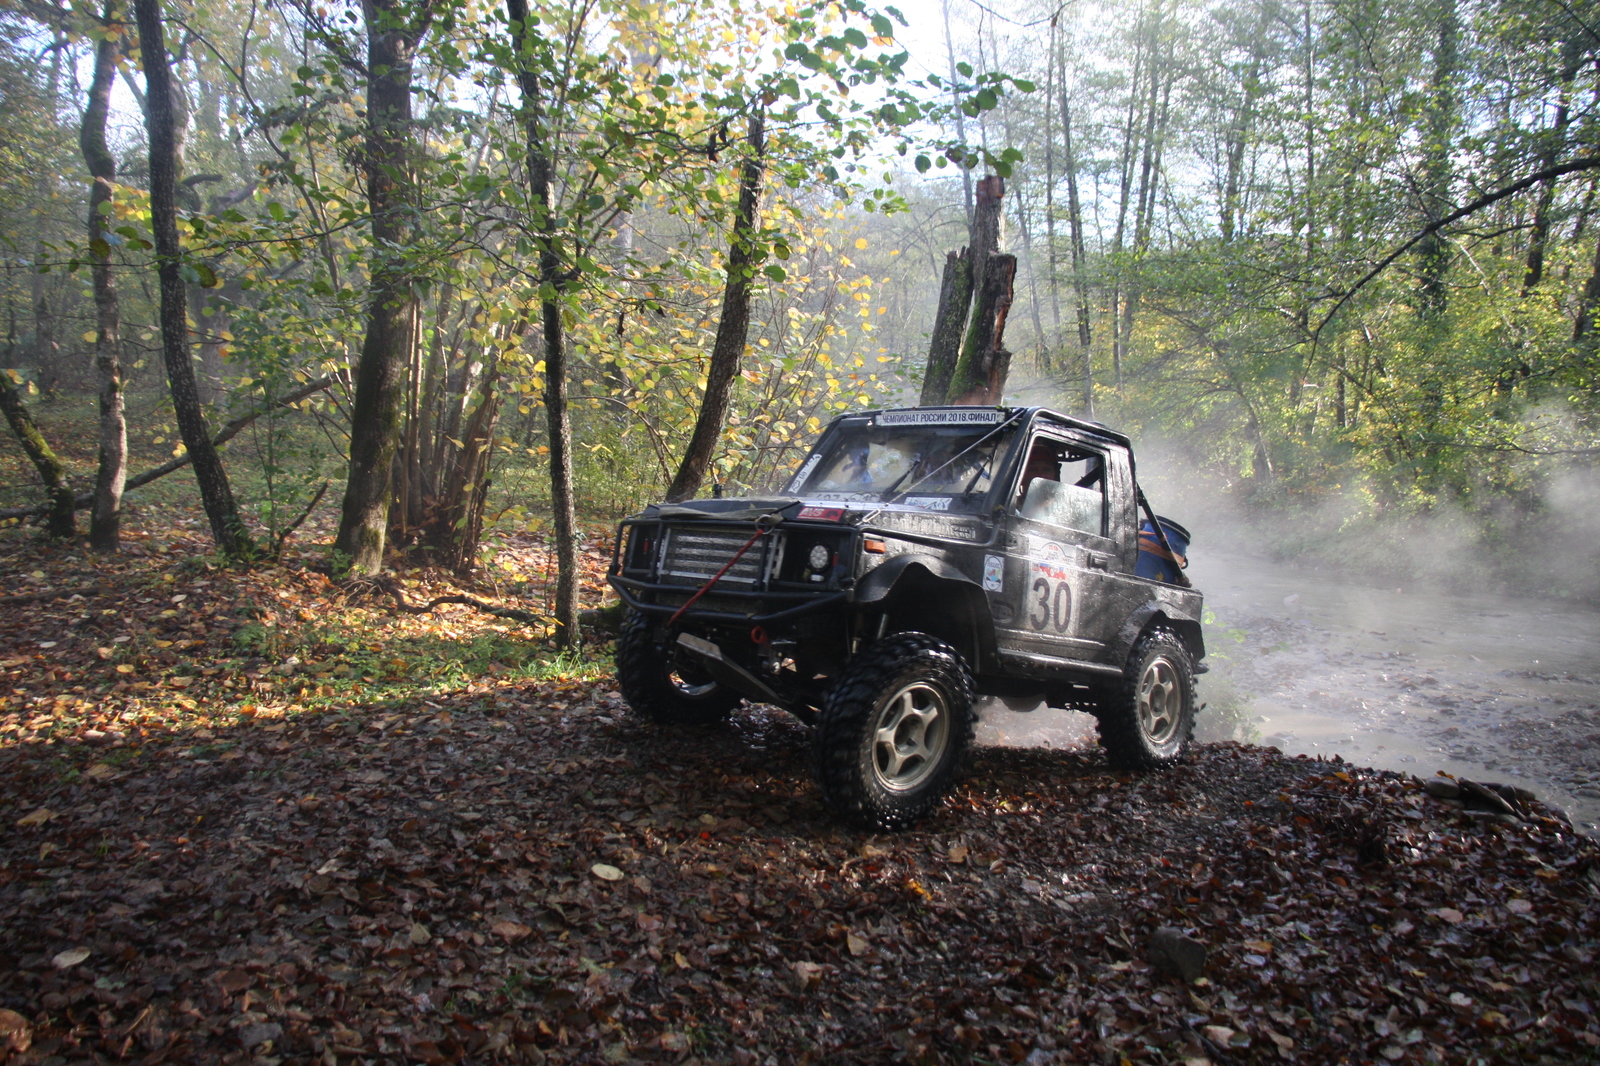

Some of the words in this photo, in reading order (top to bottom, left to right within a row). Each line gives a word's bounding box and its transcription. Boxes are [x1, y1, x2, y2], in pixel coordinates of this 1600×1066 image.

[882, 414, 920, 424] ЧЕМПИОНАТ
[920, 413, 947, 422] РОССИИ
[1030, 577, 1072, 634] 30
